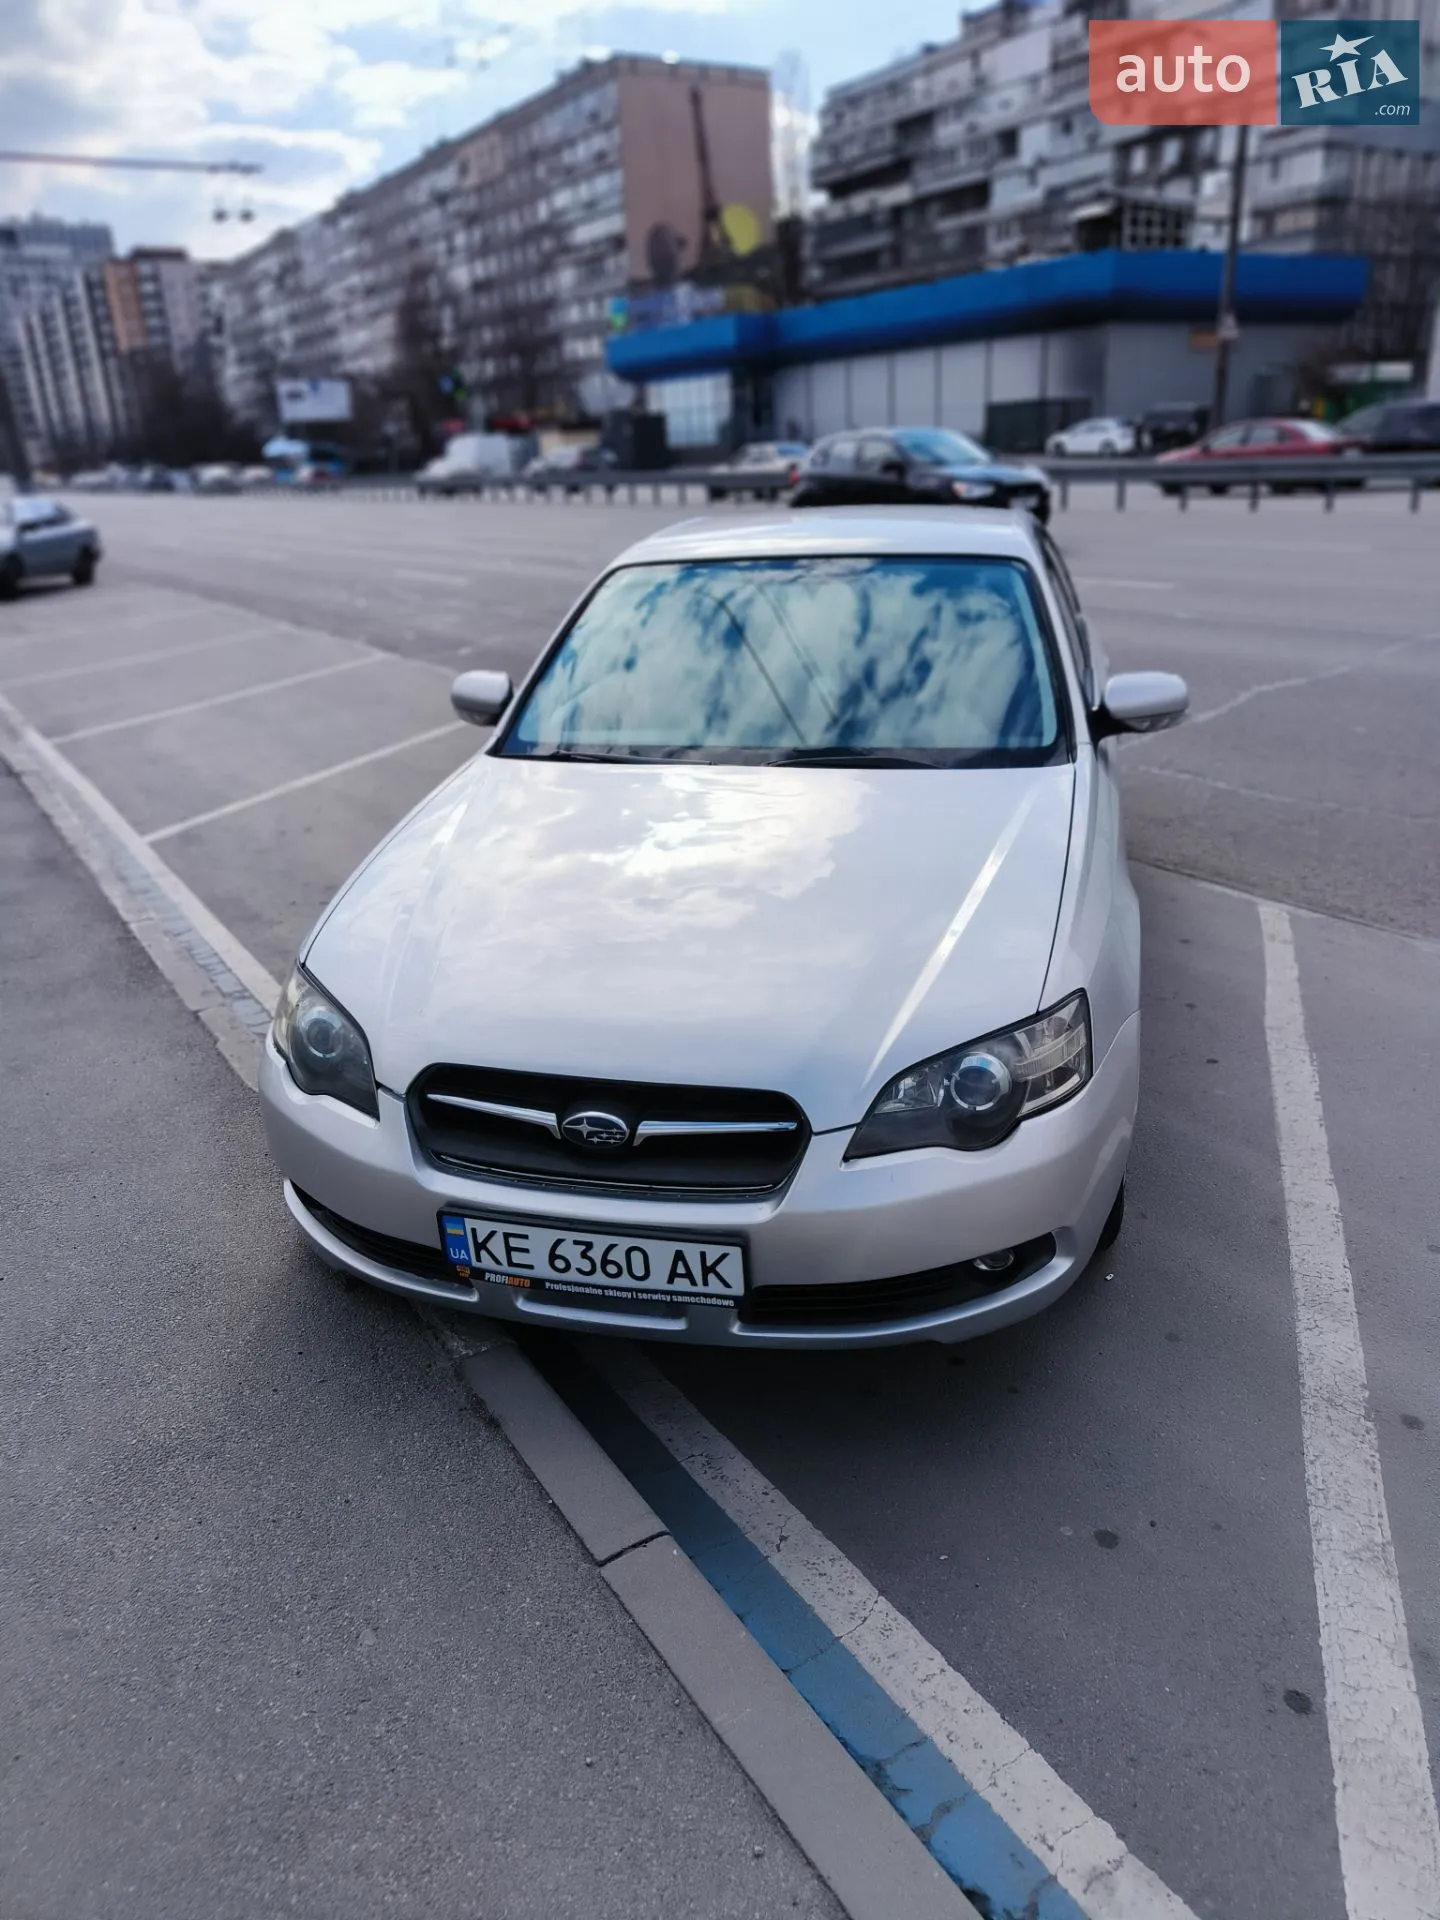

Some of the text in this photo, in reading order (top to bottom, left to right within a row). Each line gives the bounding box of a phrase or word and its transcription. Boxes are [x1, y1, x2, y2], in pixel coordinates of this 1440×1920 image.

[450, 1247, 469, 1261] UA
[470, 1227, 732, 1289] KE 6360 AK
[484, 1272, 531, 1288] PROFIAUTO
[638, 1292, 670, 1303] serwisy
[672, 1294, 734, 1307] samochodowe
